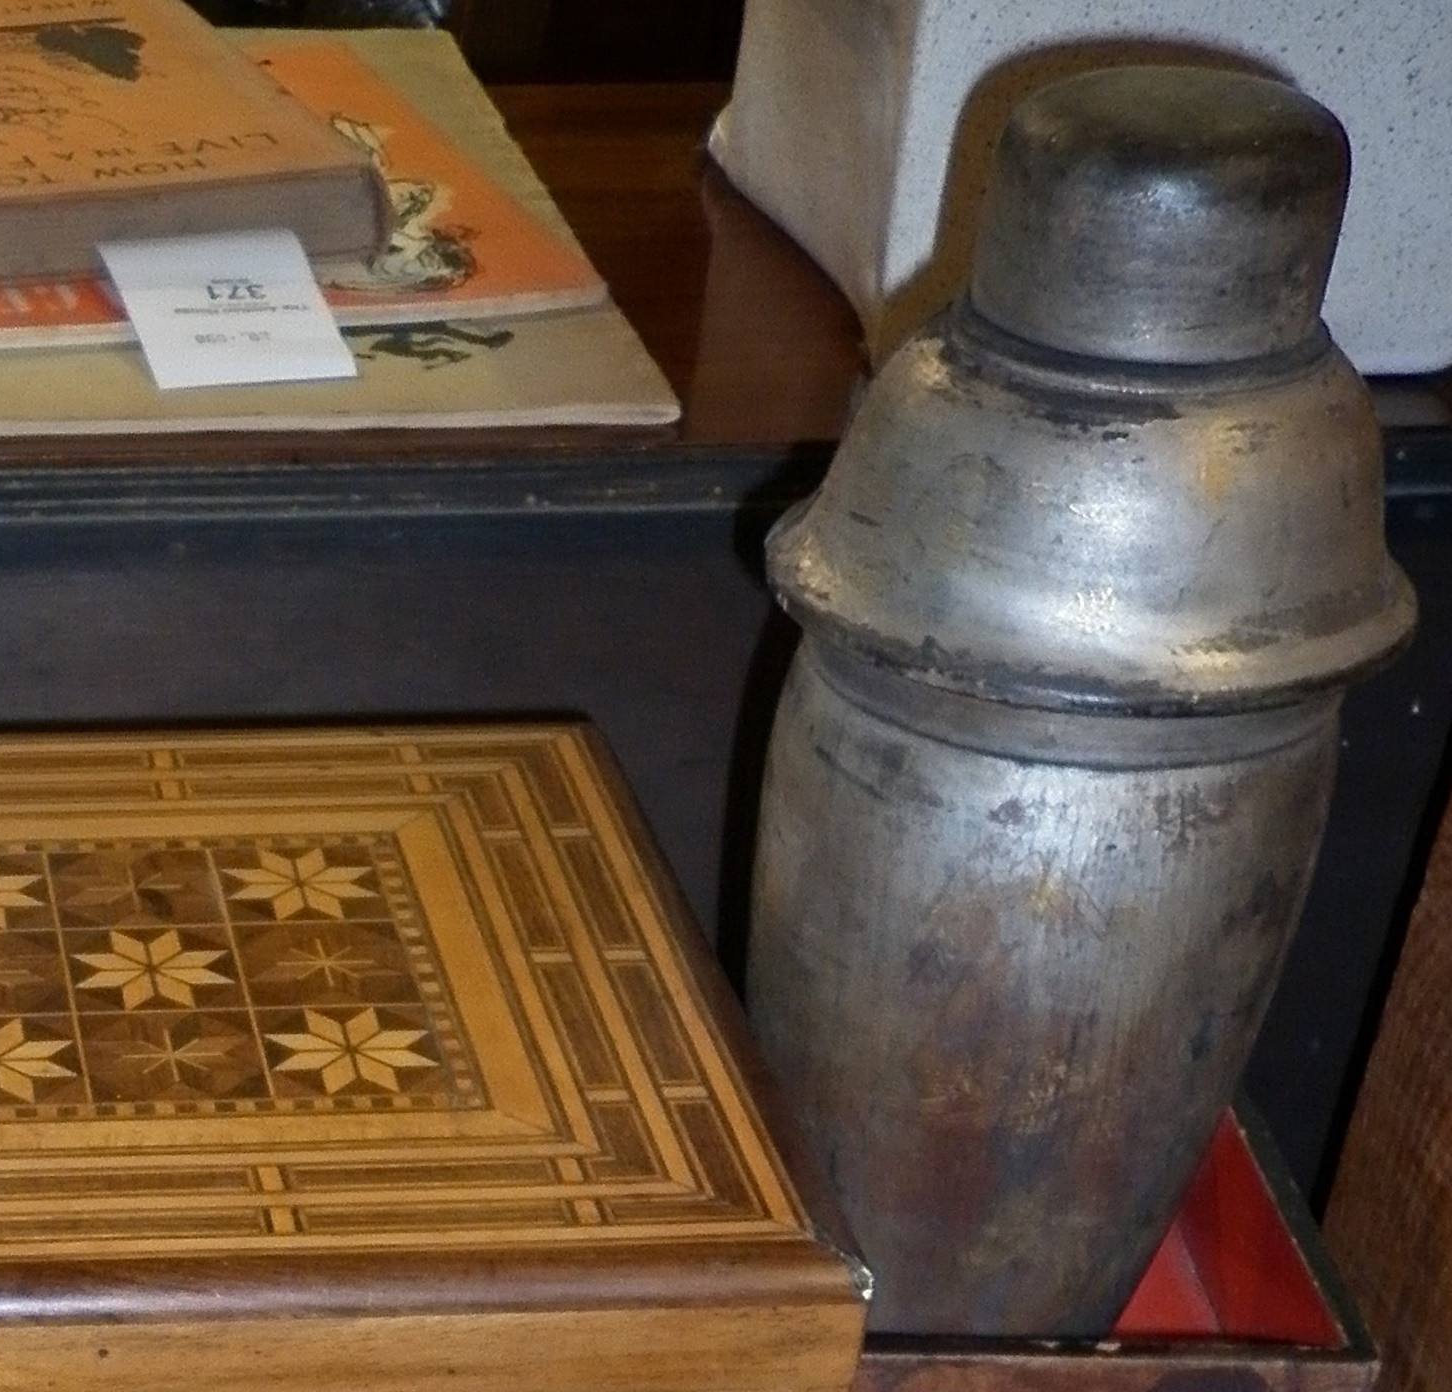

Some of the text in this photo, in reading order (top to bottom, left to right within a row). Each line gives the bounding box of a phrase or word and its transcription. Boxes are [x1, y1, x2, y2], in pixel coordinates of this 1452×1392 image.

[156, 132, 279, 156] LIVE
[51, 151, 75, 162] A
[93, 146, 136, 159] IN
[93, 157, 207, 181] HOW
[206, 284, 266, 300] 371
